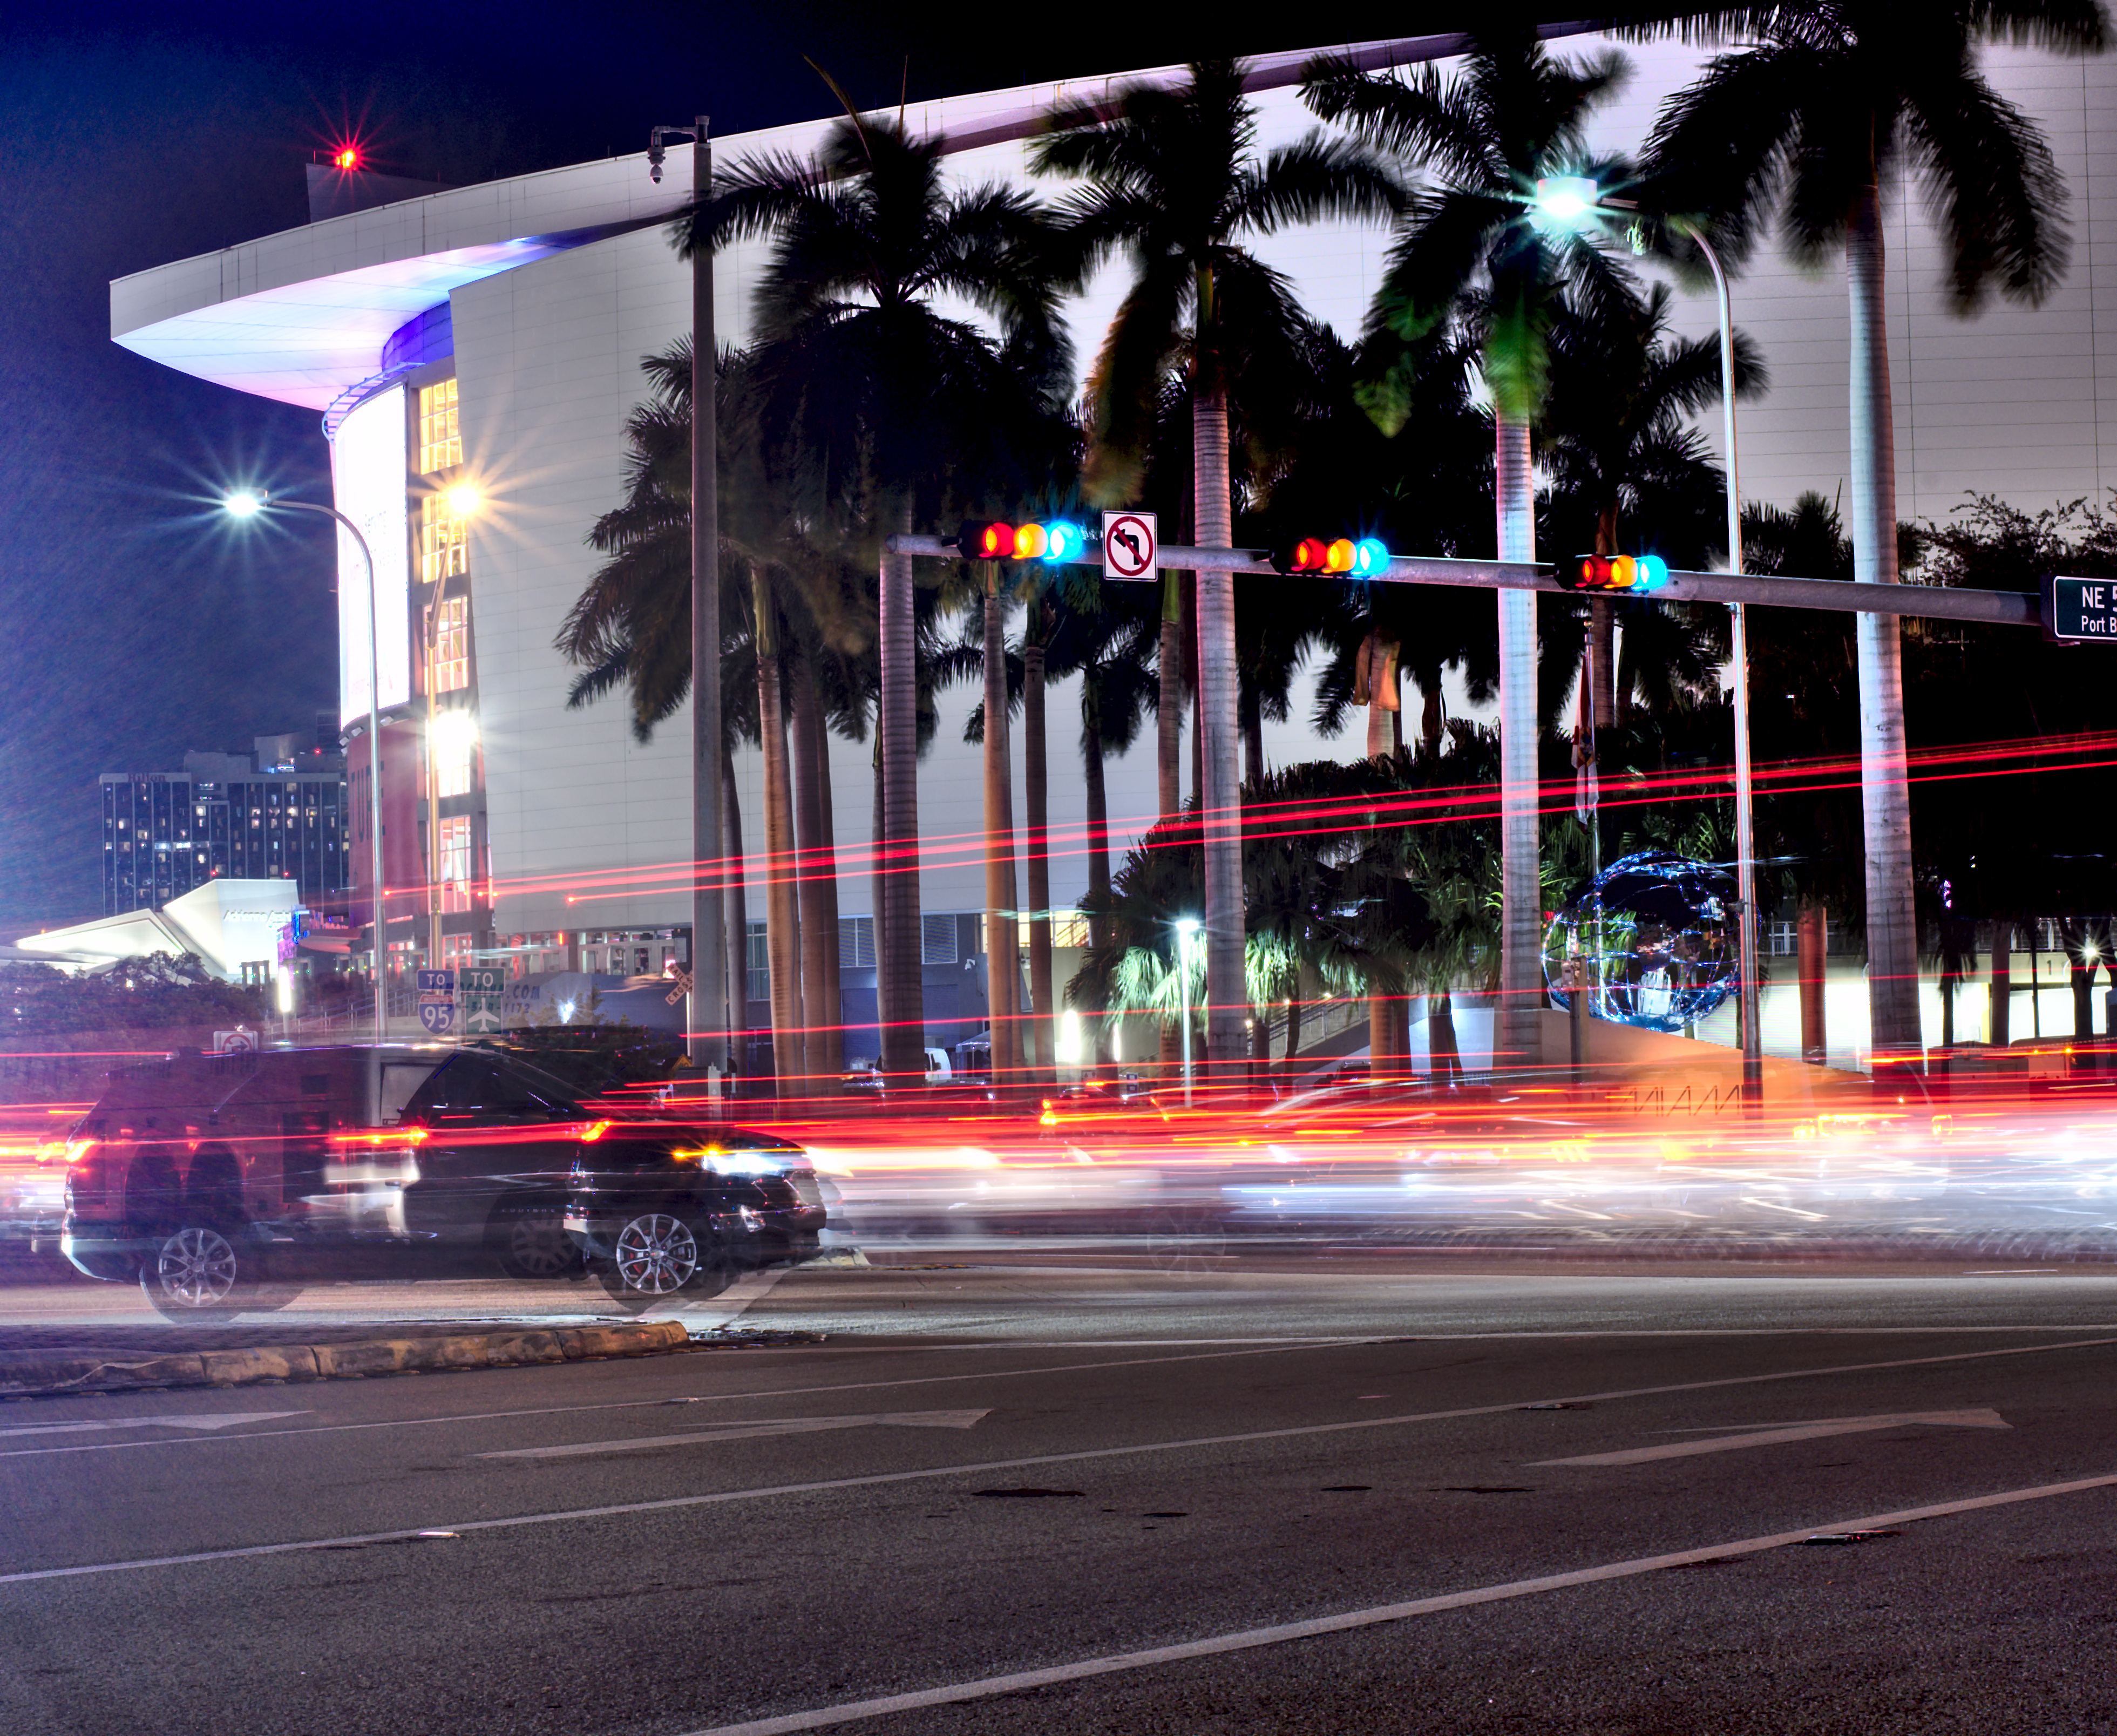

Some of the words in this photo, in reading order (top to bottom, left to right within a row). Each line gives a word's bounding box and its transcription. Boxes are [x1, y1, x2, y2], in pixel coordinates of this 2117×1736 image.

[2082, 586, 2105, 608] NE
[2081, 615, 2105, 633] Port
[128, 772, 166, 783] Hilton
[427, 974, 445, 986] TO
[471, 972, 493, 987] TO
[425, 1006, 449, 1029] 95
